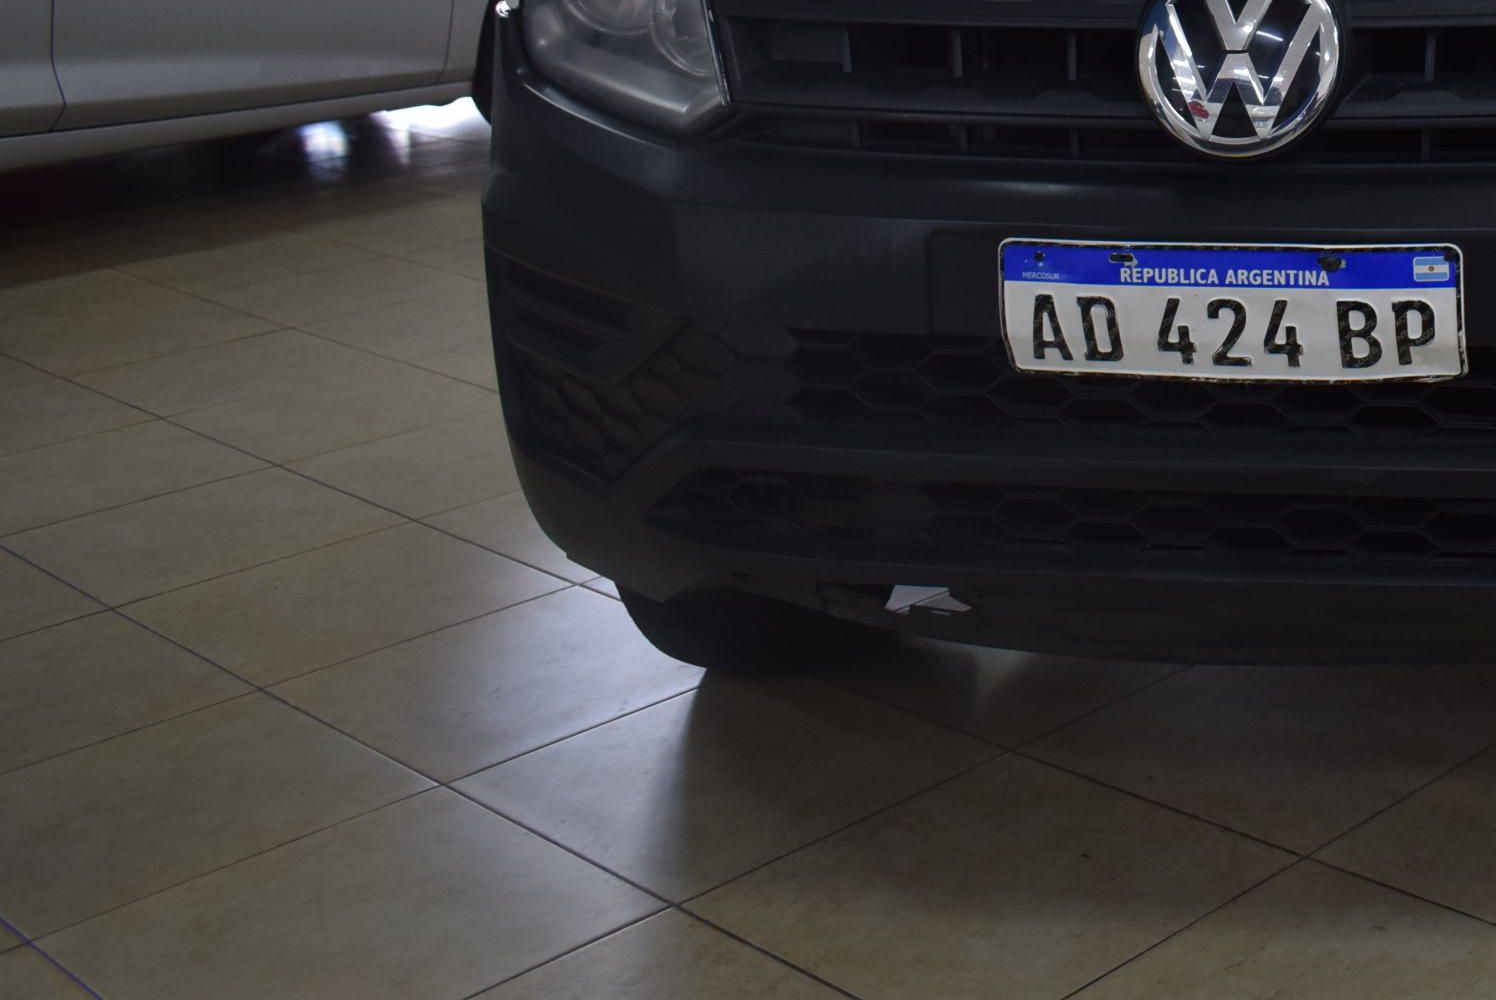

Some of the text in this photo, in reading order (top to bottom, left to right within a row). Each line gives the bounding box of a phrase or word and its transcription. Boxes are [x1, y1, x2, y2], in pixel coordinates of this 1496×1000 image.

[1022, 271, 1061, 281] MERCOSUR
[1119, 267, 1330, 287] REPUBLICA ARGENTINA
[1032, 293, 1437, 369] AD 424 BP
